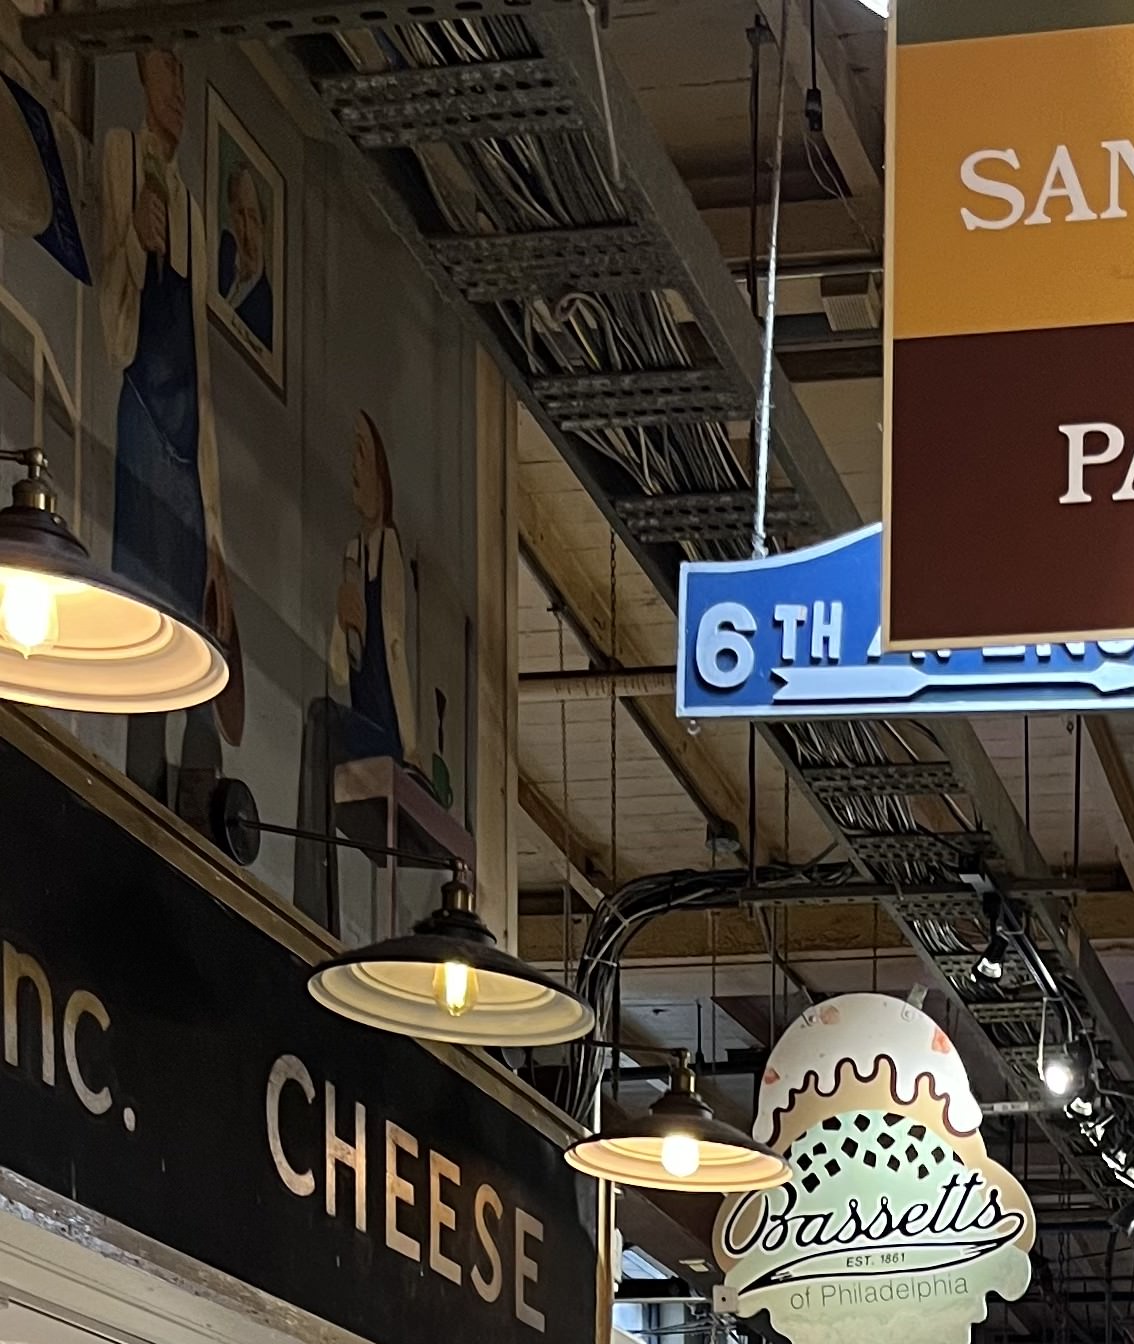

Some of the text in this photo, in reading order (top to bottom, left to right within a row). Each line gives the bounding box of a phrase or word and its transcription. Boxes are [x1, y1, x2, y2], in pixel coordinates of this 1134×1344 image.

[266, 1053, 548, 1333] CHEESE
[724, 1173, 1023, 1255] Bassetts
[846, 1252, 906, 1268] EST. 1861
[790, 1274, 969, 1310] of Philadelphia
